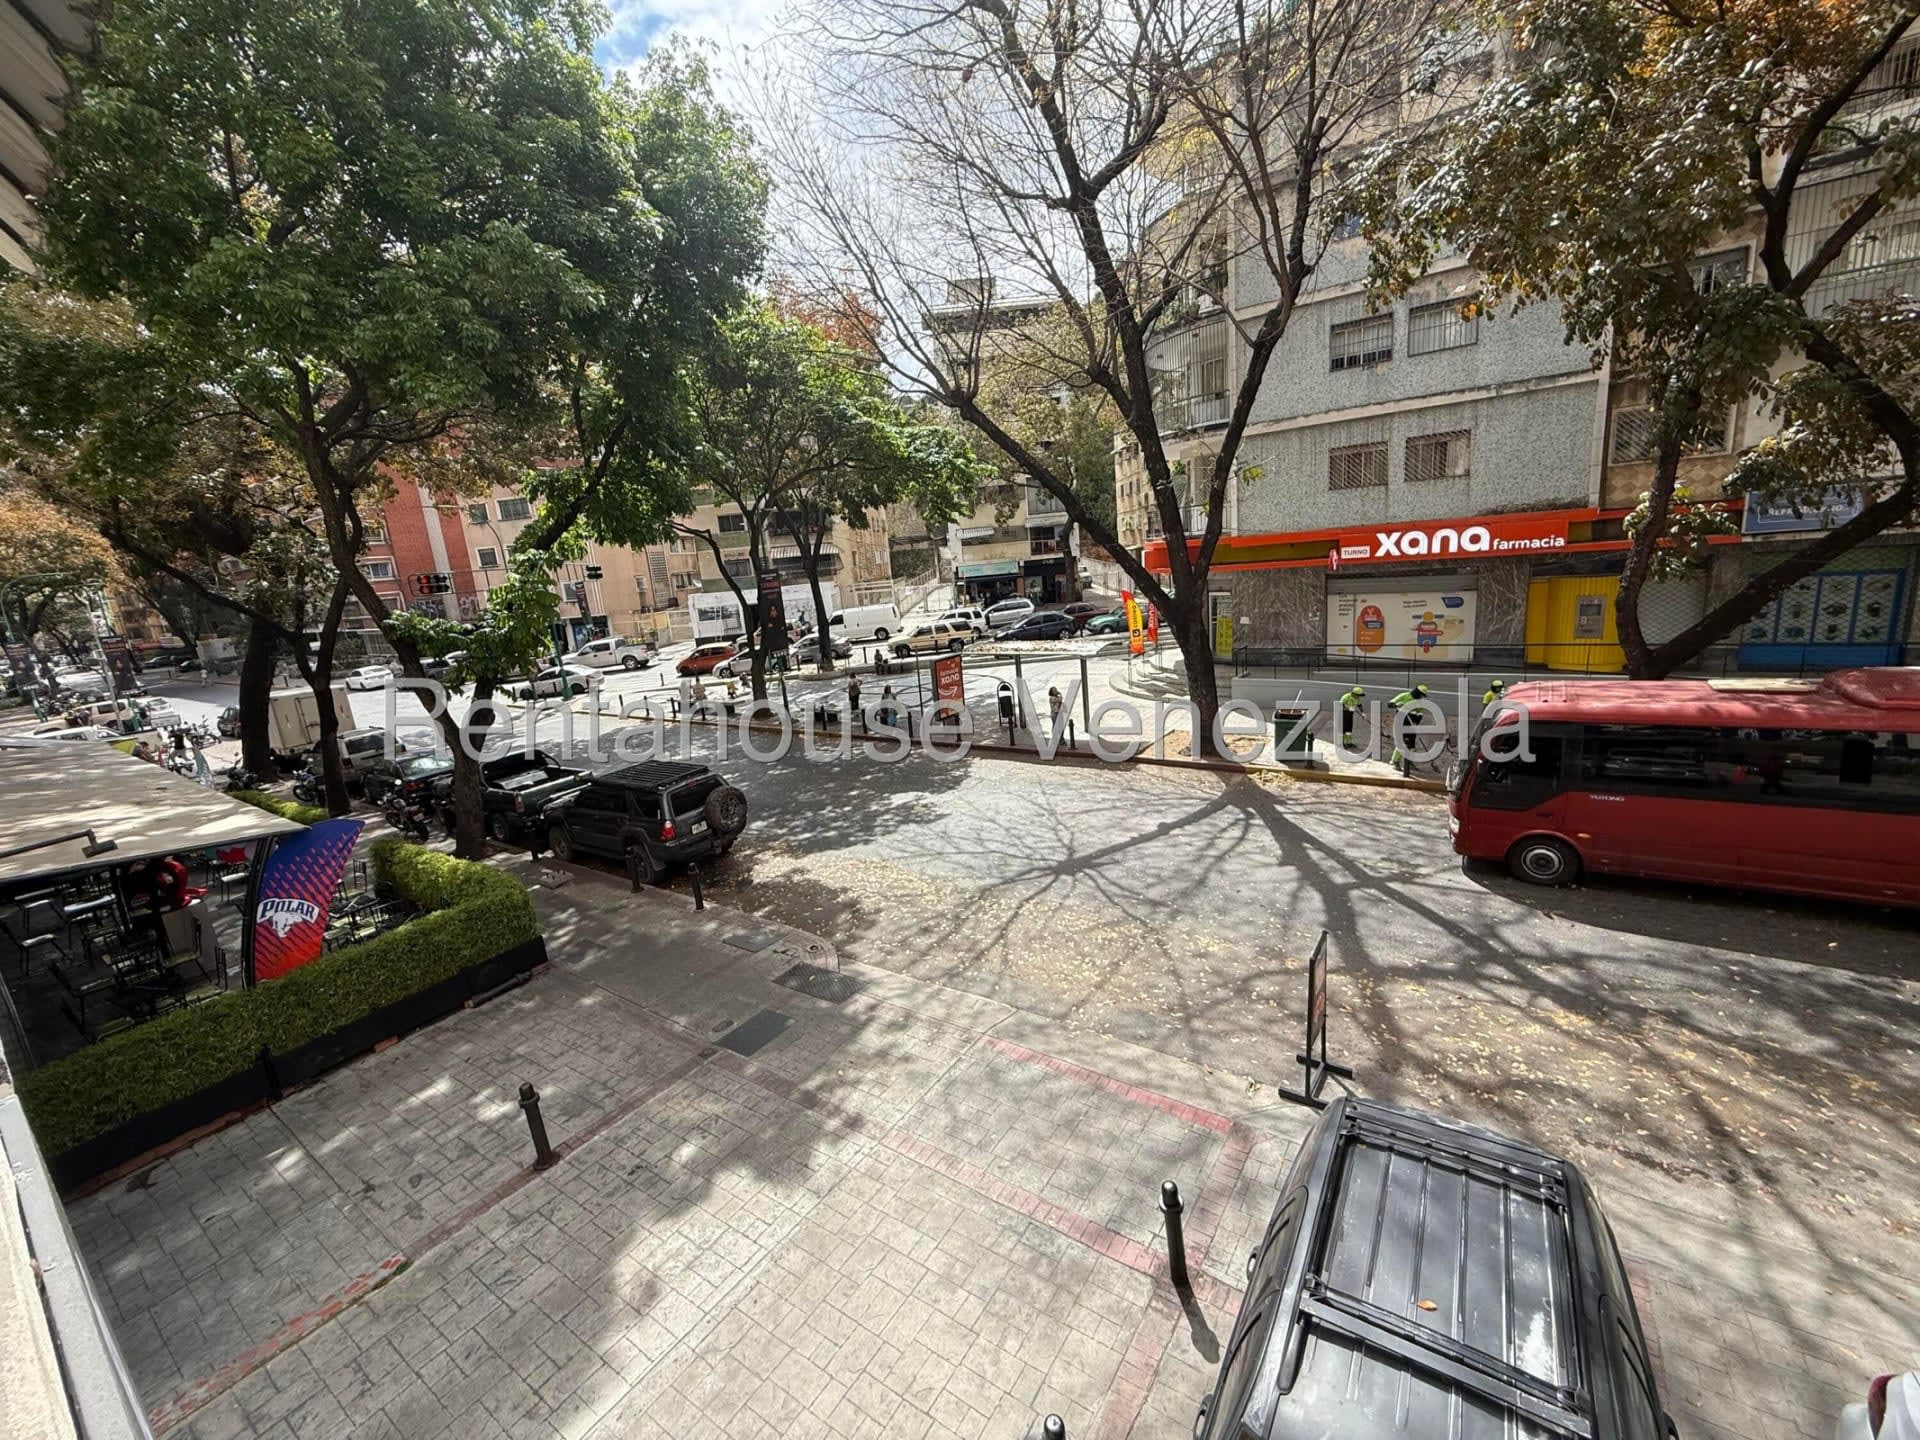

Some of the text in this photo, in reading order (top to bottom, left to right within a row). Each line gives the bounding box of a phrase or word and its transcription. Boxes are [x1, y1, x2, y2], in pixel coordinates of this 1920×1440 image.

[1375, 526, 1565, 557] xana farmacia
[1343, 548, 1368, 556] TURNO
[261, 900, 315, 920] POLAR
